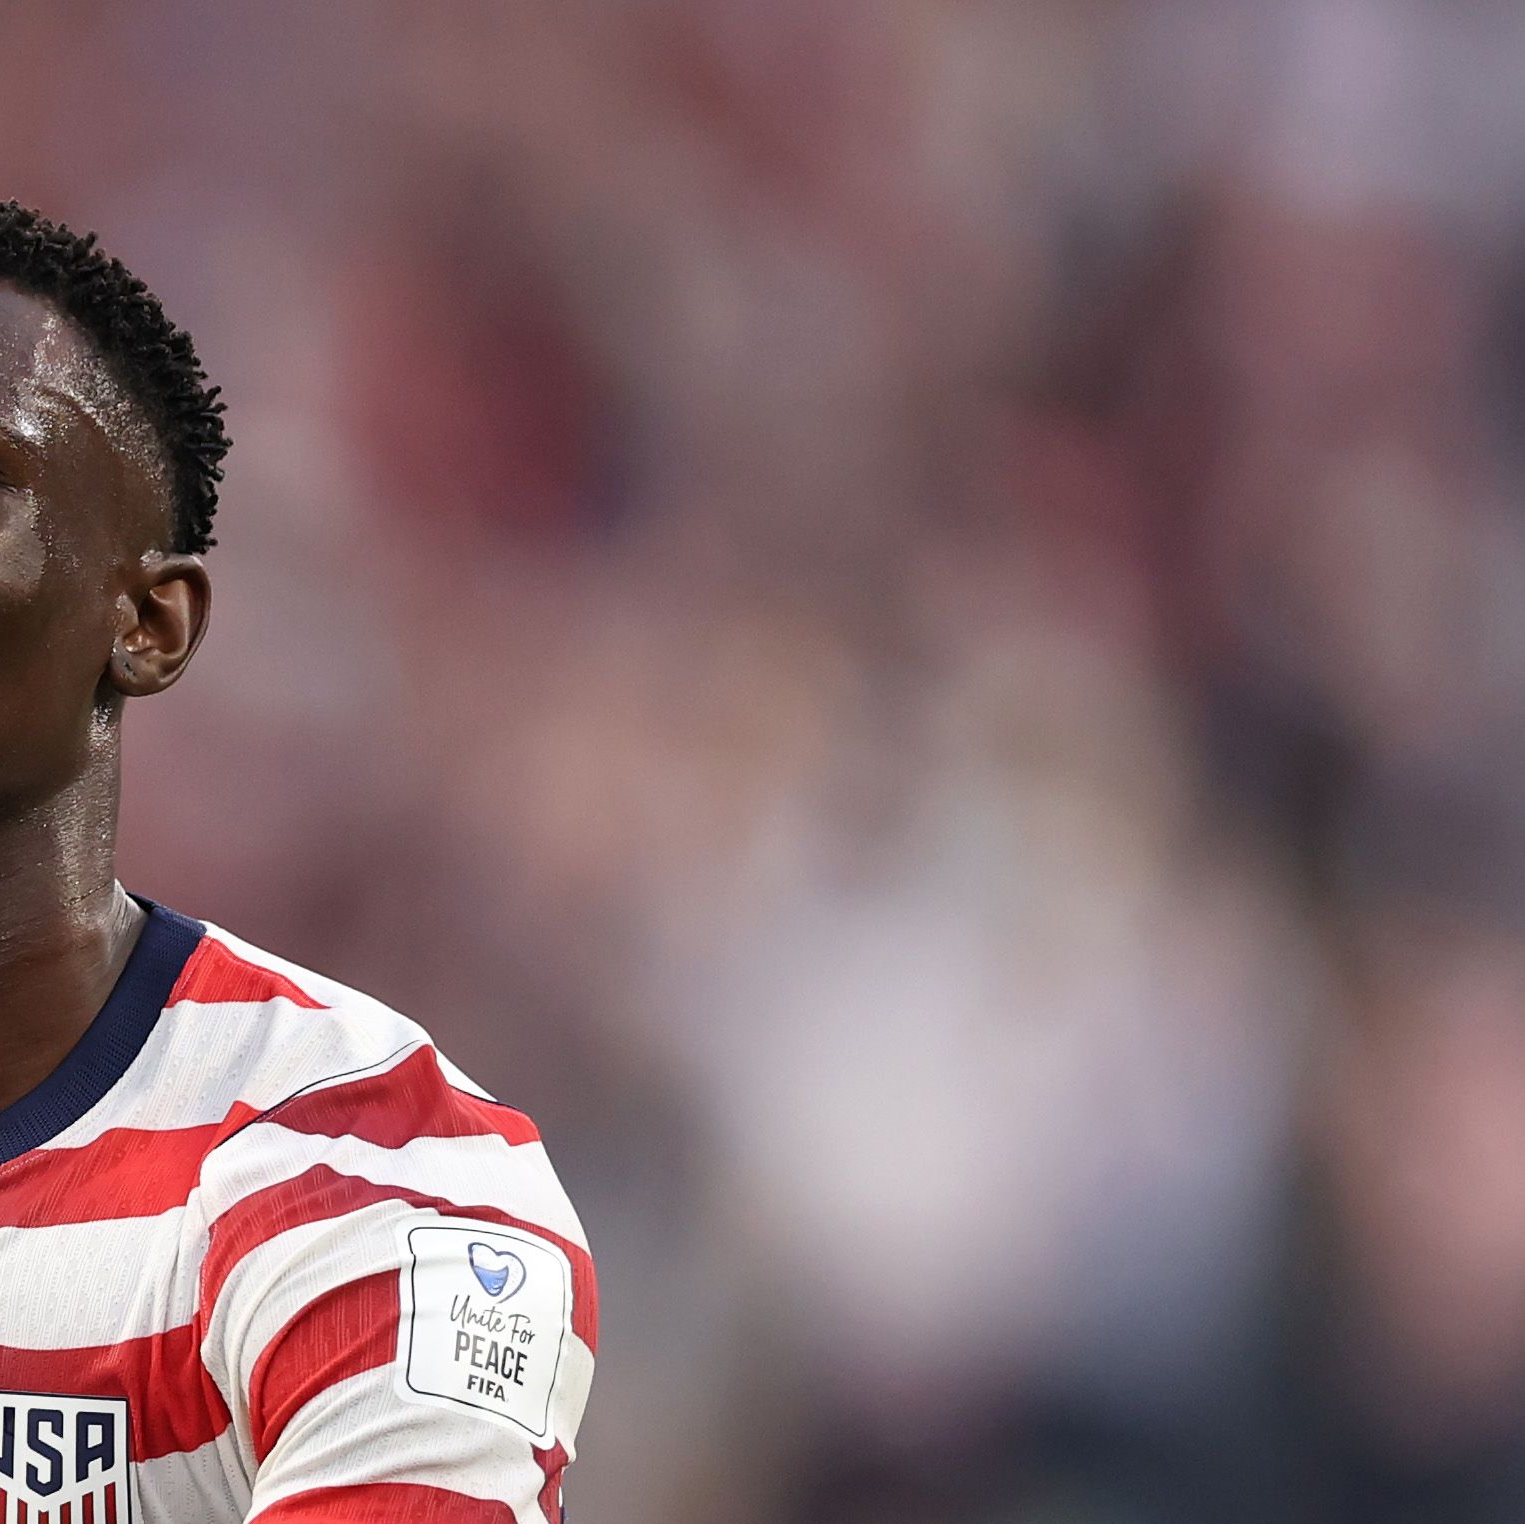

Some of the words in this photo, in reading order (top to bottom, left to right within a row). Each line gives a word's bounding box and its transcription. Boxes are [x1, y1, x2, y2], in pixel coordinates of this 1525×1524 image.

[449, 1294, 506, 1332] Unite
[507, 1313, 536, 1346] For
[454, 1330, 528, 1386] PEACE
[466, 1374, 507, 1402] FIFA
